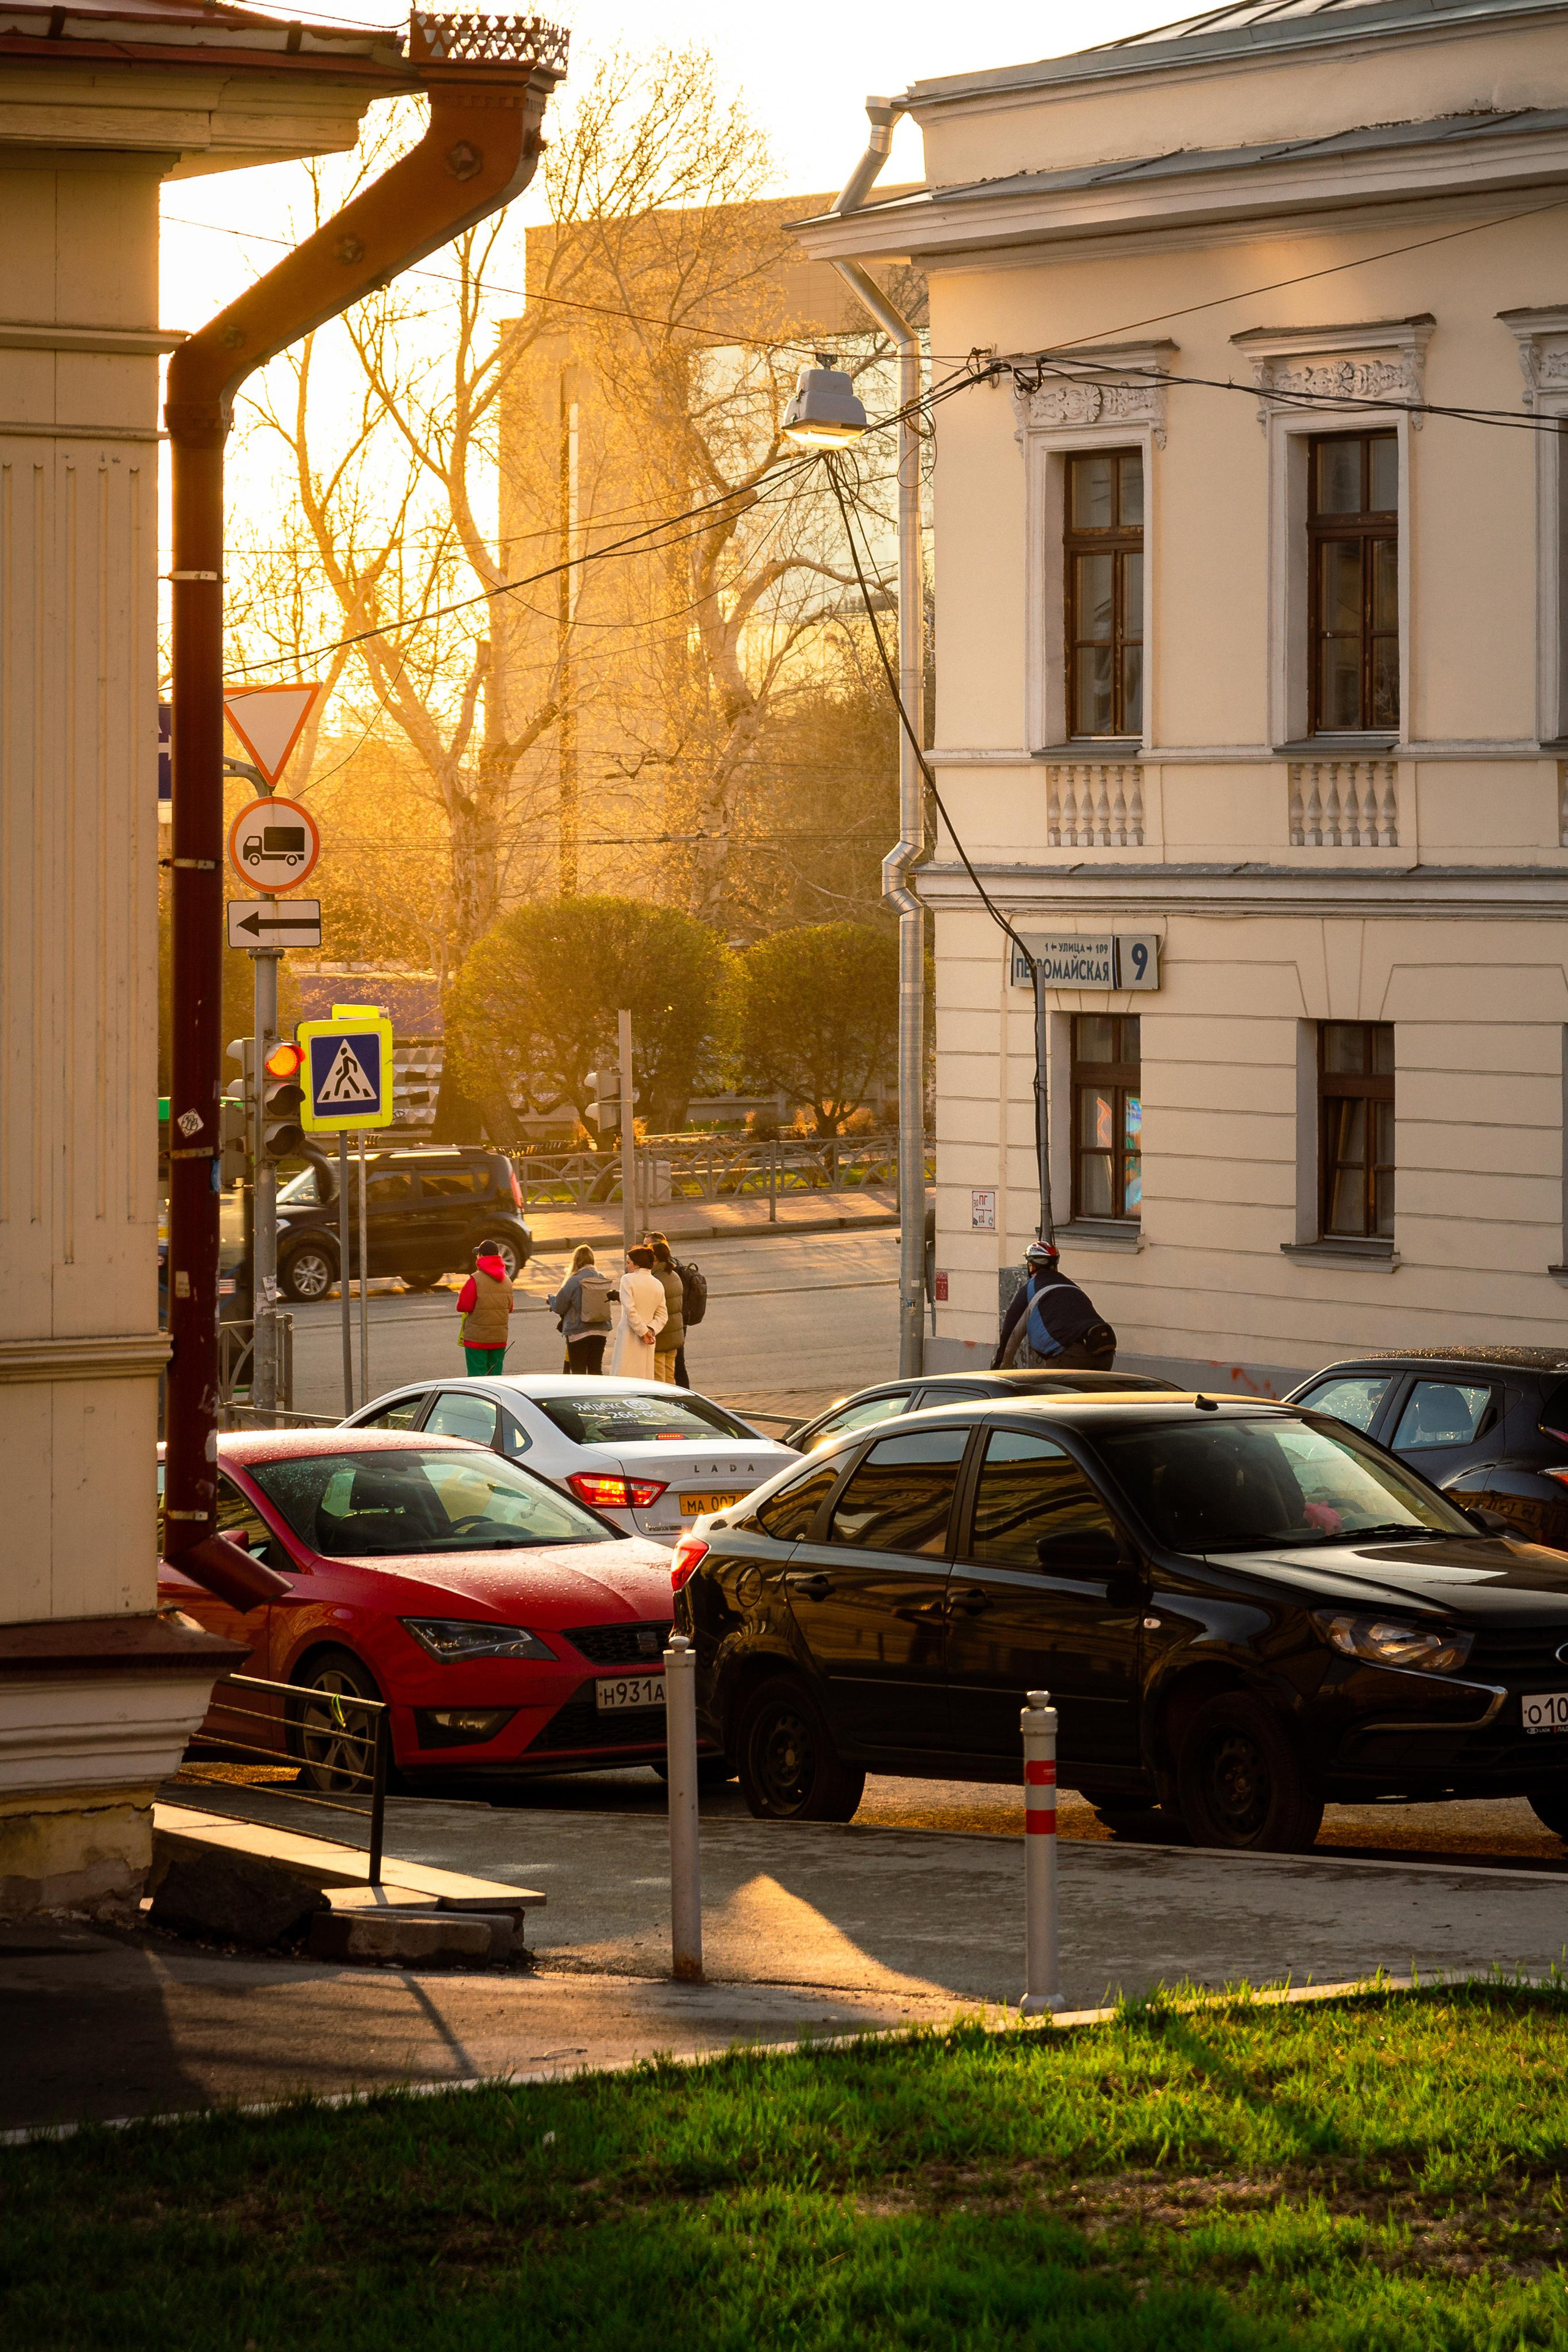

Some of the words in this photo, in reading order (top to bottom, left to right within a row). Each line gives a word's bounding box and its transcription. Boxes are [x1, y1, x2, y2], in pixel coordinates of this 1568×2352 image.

[1045, 943, 1048, 952] 1
[1058, 943, 1085, 954] УЛИЦА
[1096, 944, 1108, 954] 109
[1131, 943, 1148, 981] 9
[1016, 955, 1109, 981] ПЕОМАЙСКАЯ
[608, 1410, 684, 1419] 266-66-66
[694, 1464, 754, 1472] LADA
[687, 1501, 705, 1512] МА
[604, 1679, 665, 1705] Н931А
